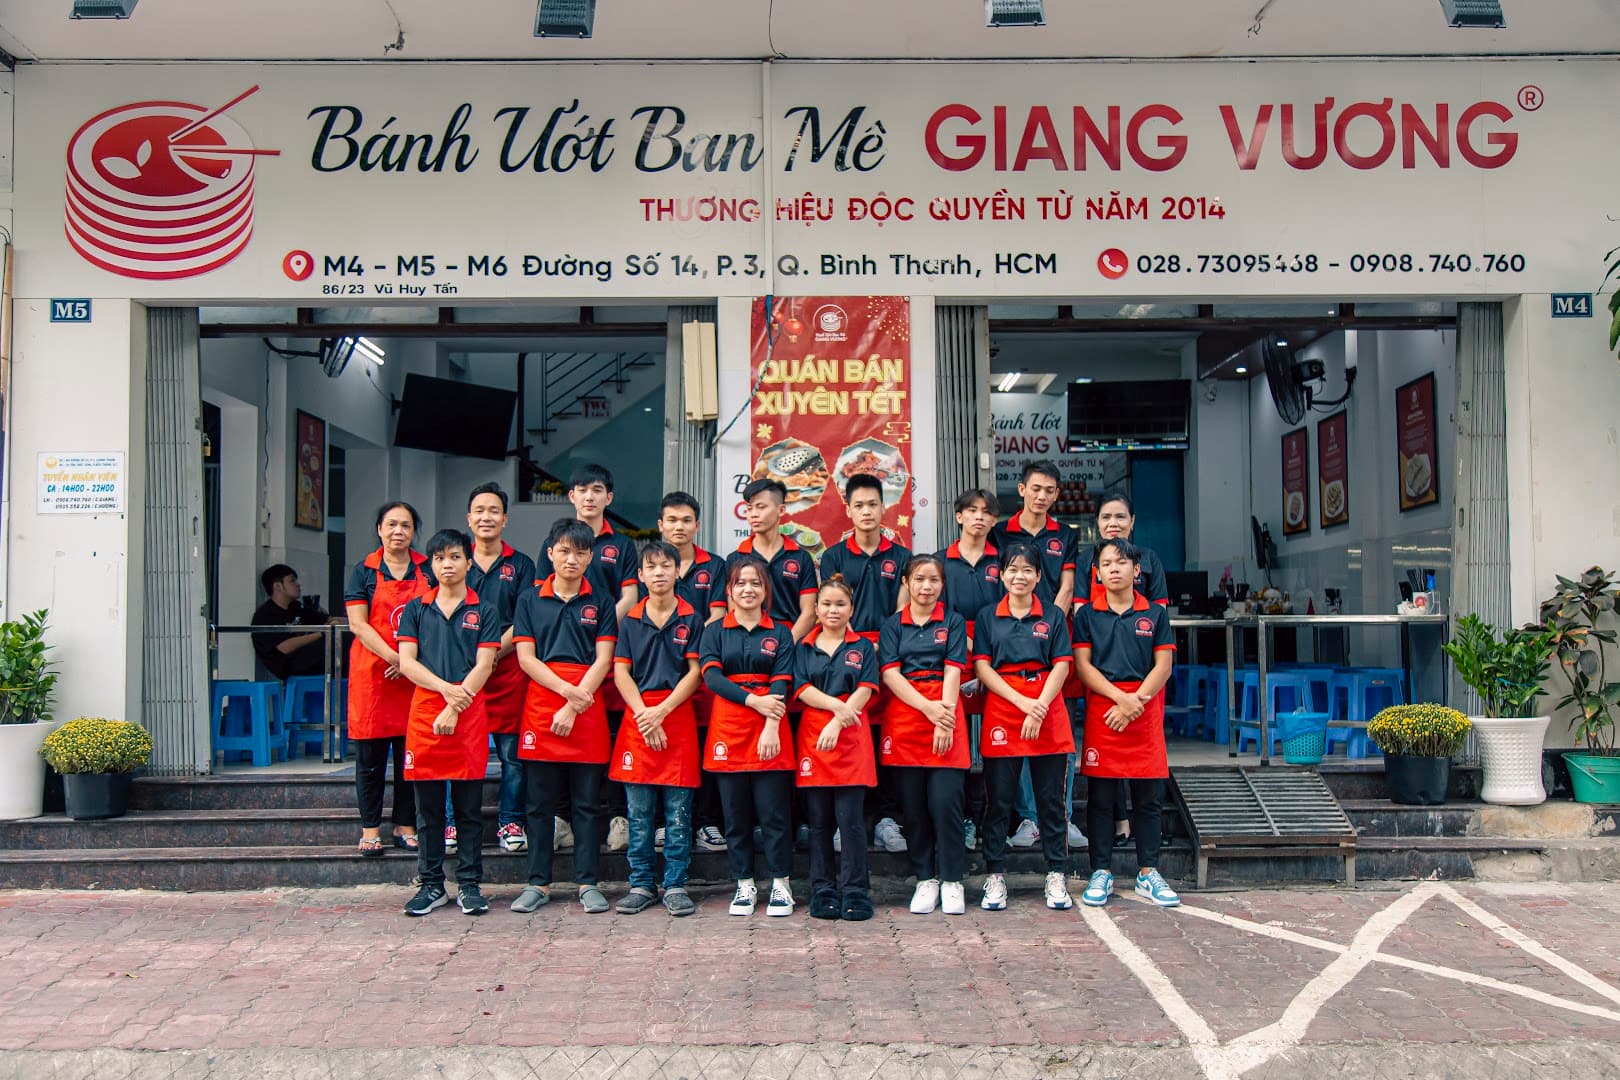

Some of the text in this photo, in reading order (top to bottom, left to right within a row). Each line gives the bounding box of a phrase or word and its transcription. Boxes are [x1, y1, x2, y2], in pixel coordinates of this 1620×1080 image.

[307, 102, 480, 173] Bánh
[493, 98, 616, 173] Ướt
[629, 105, 764, 173] Ban
[924, 103, 1189, 172] GIANG
[1218, 96, 1519, 171] VƯƠNG
[639, 188, 1227, 228] THƯƠNG HIỆU ĐỘC QUYỀN TỪ NĂM 2014
[324, 255, 364, 277] M4
[397, 255, 436, 277] M5
[467, 254, 508, 277] M6
[522, 253, 612, 282] Đường
[625, 252, 661, 276] Số
[777, 254, 809, 276] Q.
[820, 254, 877, 276] Bình
[995, 252, 1057, 274] HCM
[1137, 253, 1319, 274] 028.73095468
[1349, 253, 1526, 273] 0908.740.760
[322, 282, 458, 297] 86/23 Vũ Huy Tấn
[54, 302, 88, 319] M5
[1554, 297, 1588, 314] M4
[757, 353, 904, 384] QUÁN BÁN
[755, 385, 907, 416] XUYÊN TẾT
[992, 411, 1062, 430] ánh Ướt
[91, 484, 115, 493] 22H00
